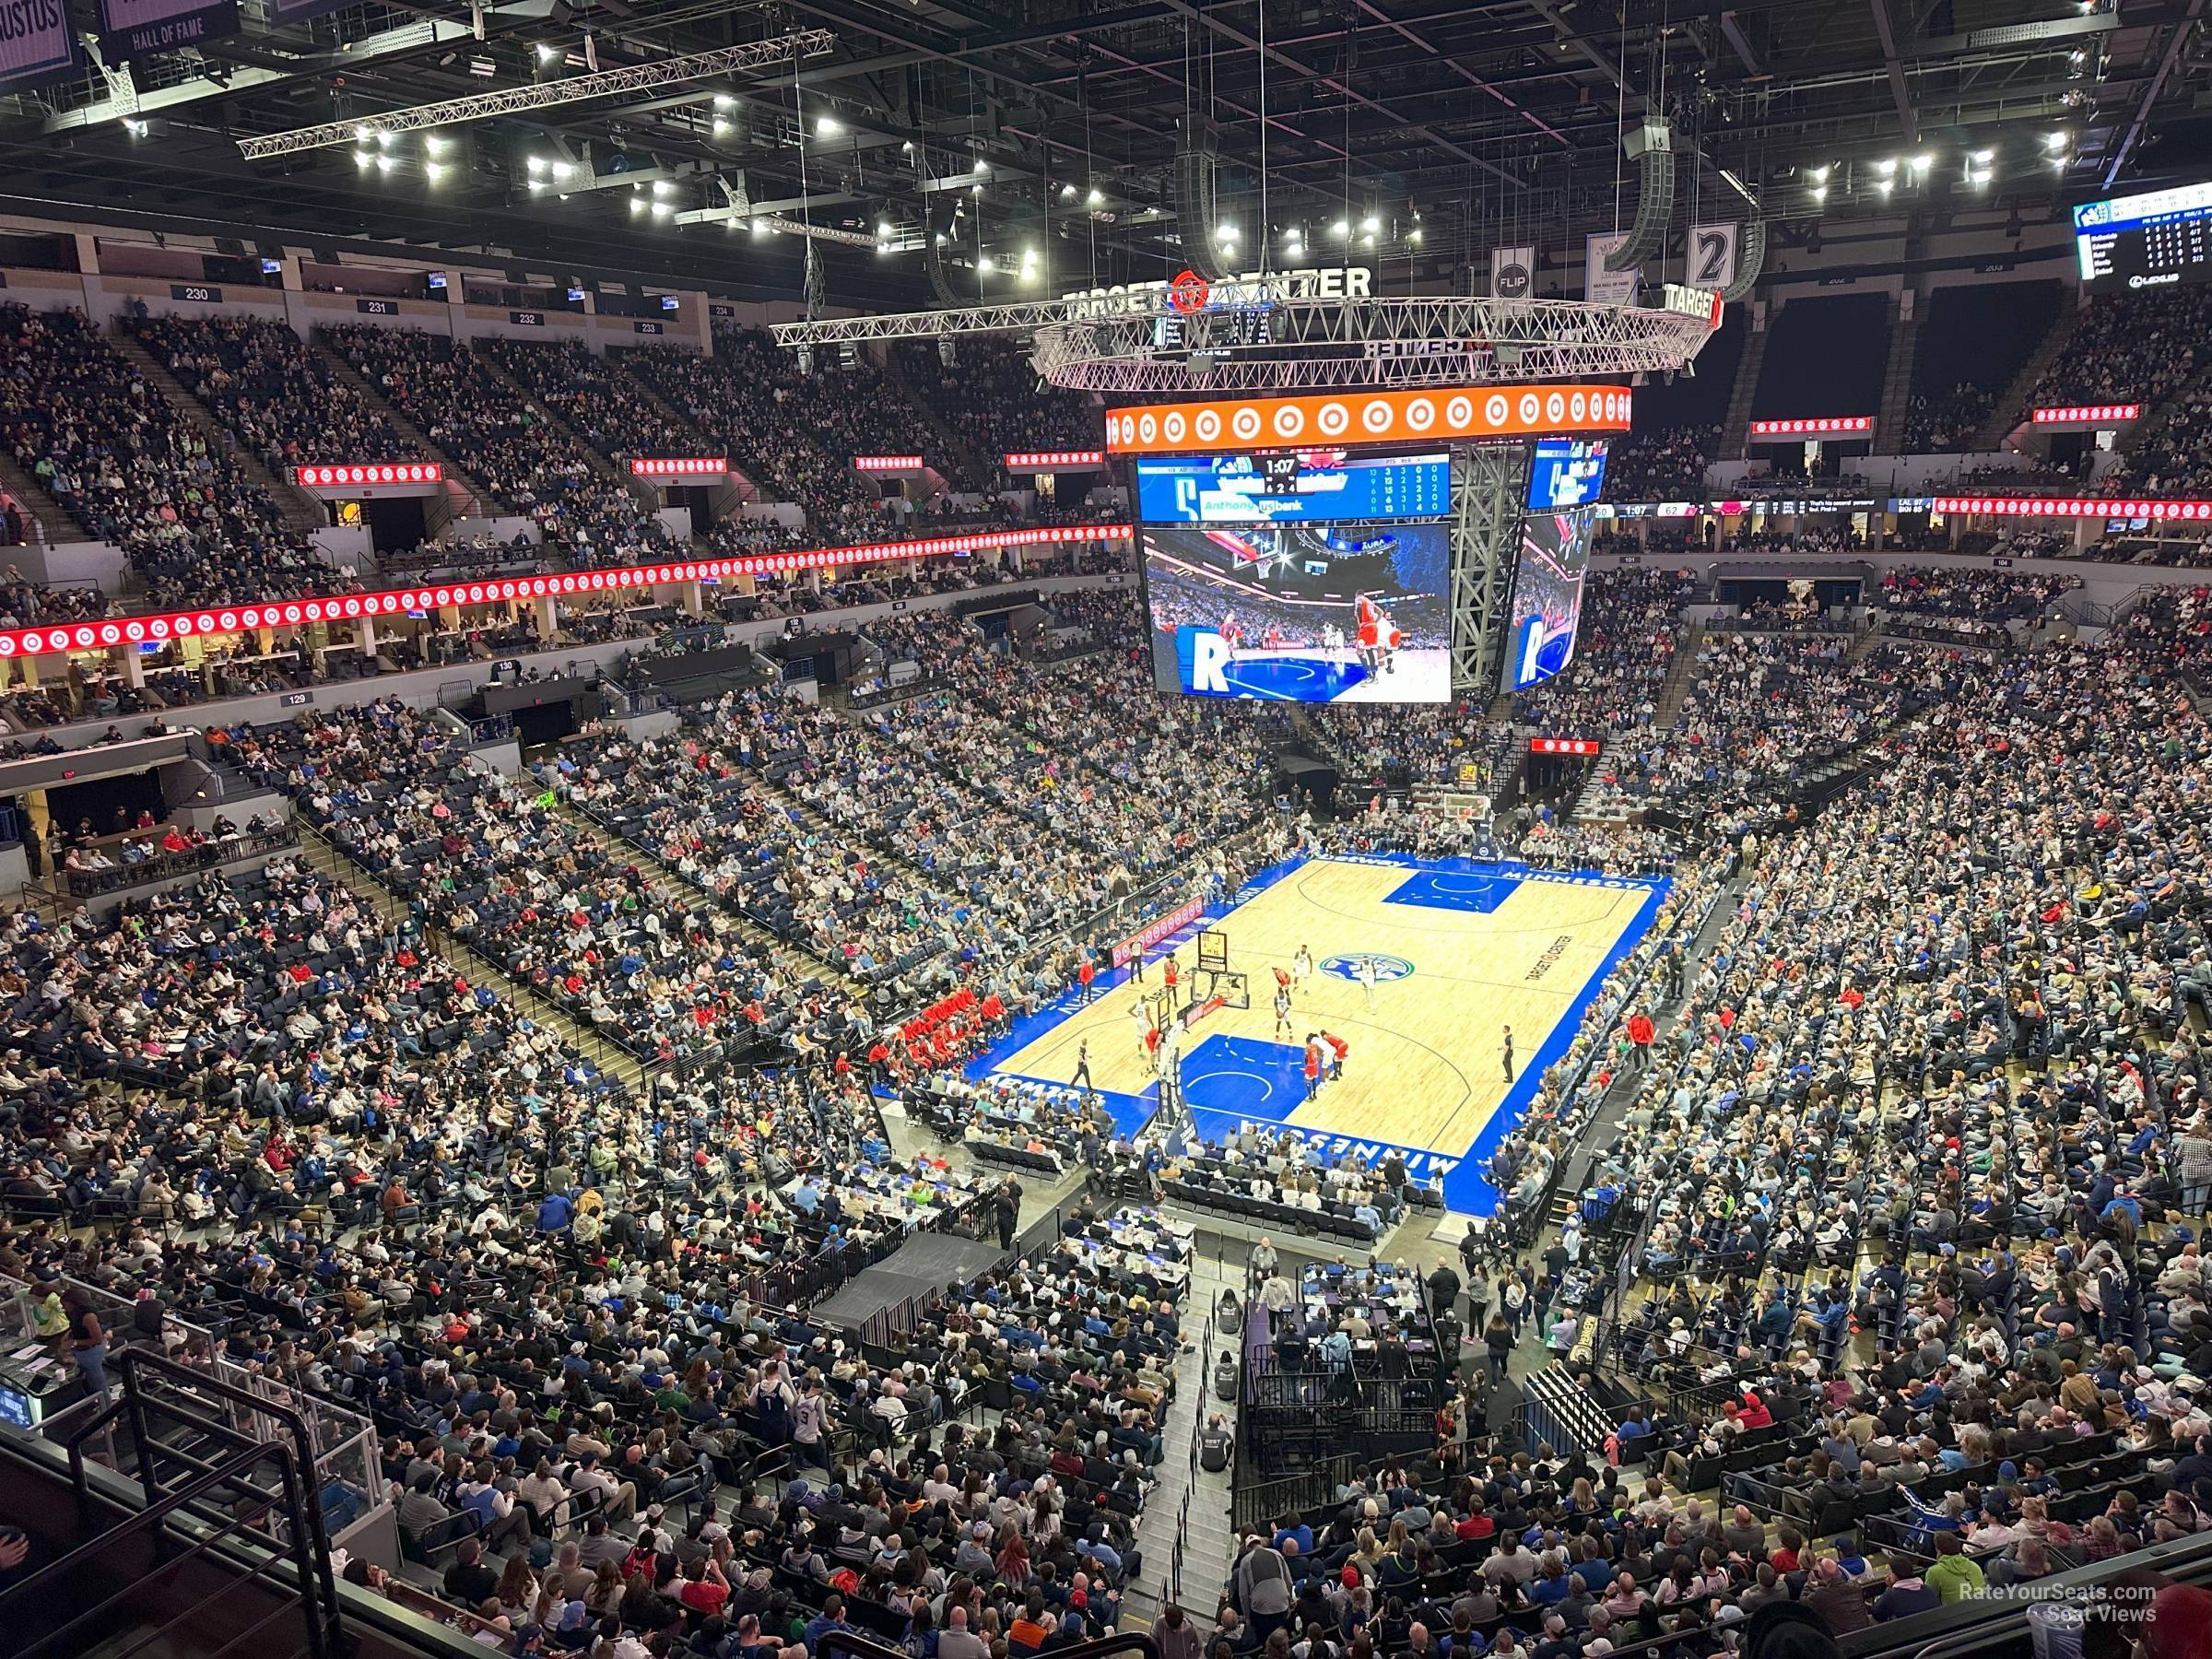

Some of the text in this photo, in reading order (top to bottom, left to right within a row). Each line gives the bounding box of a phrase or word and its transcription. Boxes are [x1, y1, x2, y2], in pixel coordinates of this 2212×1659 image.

[0, 1, 60, 43] USTUS
[132, 17, 205, 52] HALL OF FAME
[1696, 230, 1728, 282] 2
[1500, 276, 1526, 288] FLIP
[186, 288, 208, 300] 230
[1063, 267, 1371, 319] TARGET CENTER
[369, 301, 386, 313] 231
[1665, 284, 1714, 319] TARGET
[716, 306, 728, 316] 234
[520, 313, 535, 324] 232
[642, 323, 655, 333] 233
[1267, 459, 1295, 473] 1:07
[1267, 483, 1295, 494] 6 2 4
[1416, 485, 1422, 493] 2
[1386, 496, 1392, 504] 6
[1416, 494, 1422, 502] 3
[1205, 501, 1253, 512] Anthony
[1416, 503, 1423, 512] 4
[1432, 502, 1438, 511] 0
[1625, 506, 1647, 515] 1:07
[1665, 506, 1677, 515] 62
[1520, 621, 1544, 683] R
[499, 662, 513, 671] 130
[1193, 632, 1230, 692] R
[288, 694, 306, 705] 129
[1503, 870, 1654, 892] MINNESOTA
[1524, 935, 1574, 980] TARGET CENTER
[766, 1398, 771, 1410] 1
[801, 1411, 809, 1424] 3
